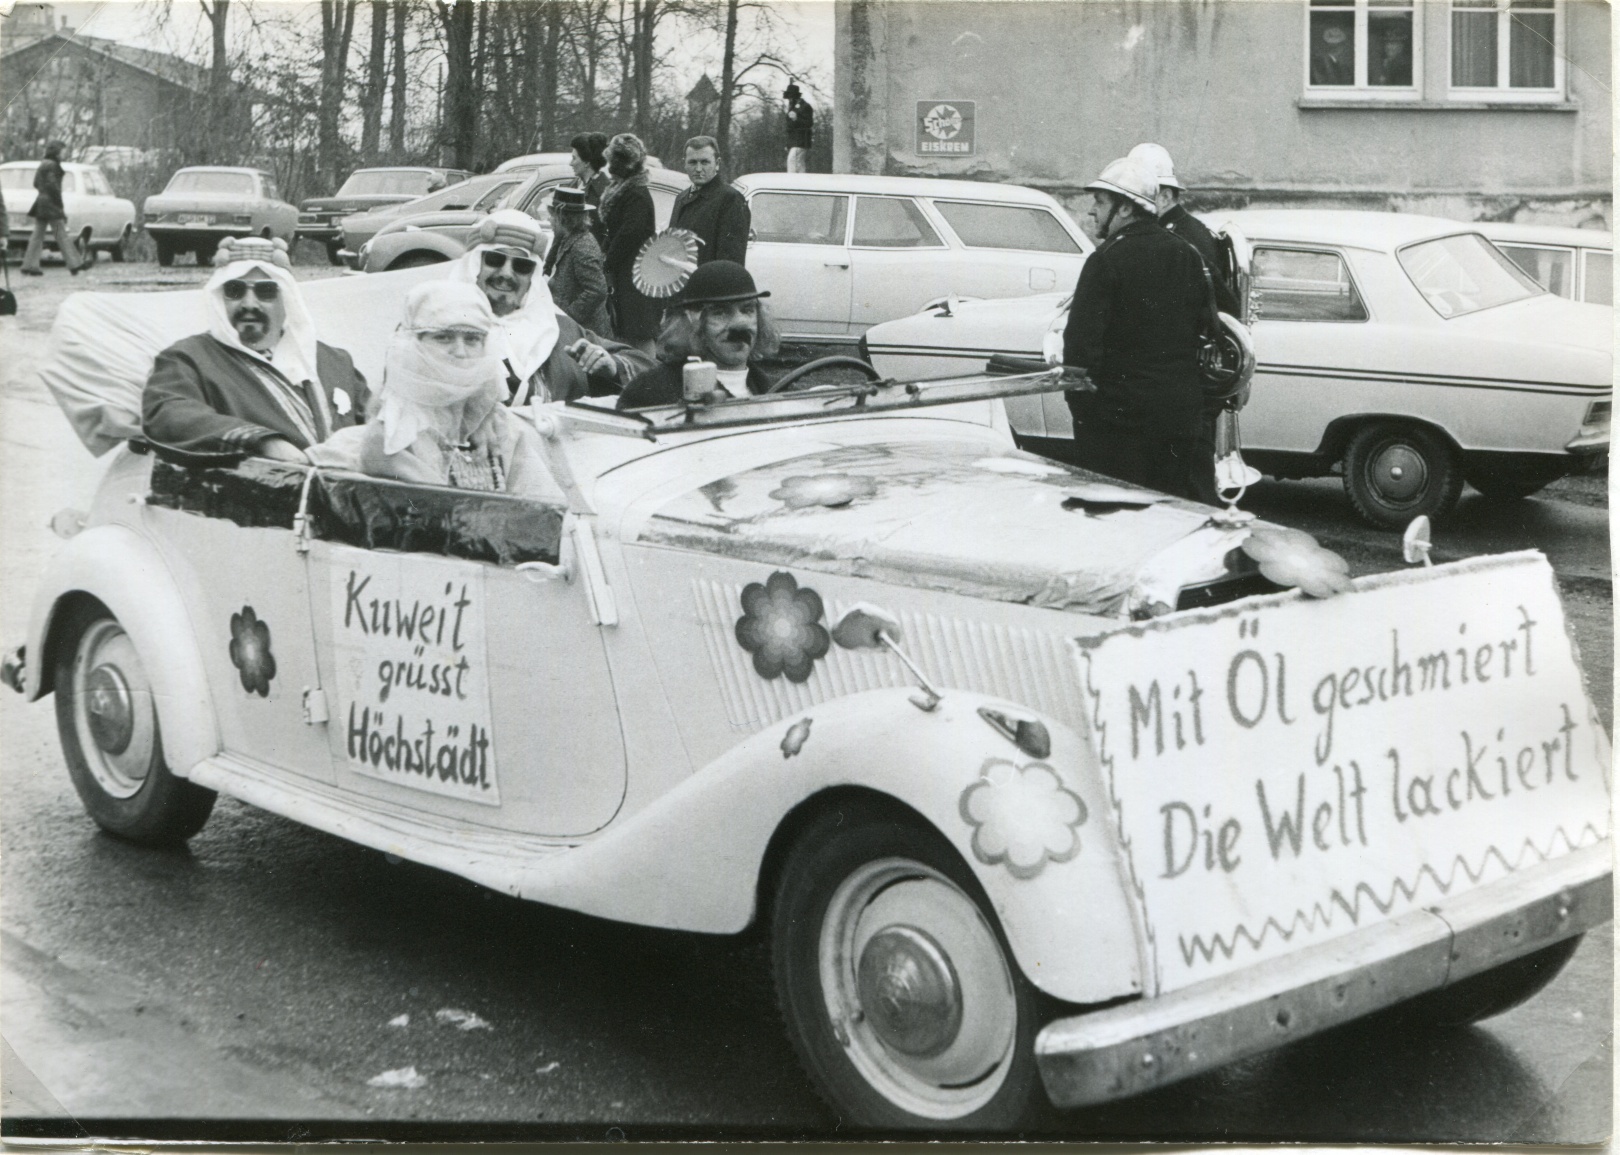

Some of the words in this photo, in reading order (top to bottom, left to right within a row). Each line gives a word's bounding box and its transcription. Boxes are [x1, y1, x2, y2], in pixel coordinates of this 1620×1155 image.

[921, 140, 969, 152] EISKREM
[345, 570, 471, 652] Kuweit
[378, 646, 470, 703] grüsst
[1128, 670, 1206, 760] Mit
[1226, 618, 1295, 729] Öl
[1312, 604, 1538, 766] geschmiert
[348, 700, 490, 790] Höchstädt
[1158, 801, 1242, 880] Die
[1255, 760, 1368, 862] Welt
[1387, 702, 1580, 825] lackiert
